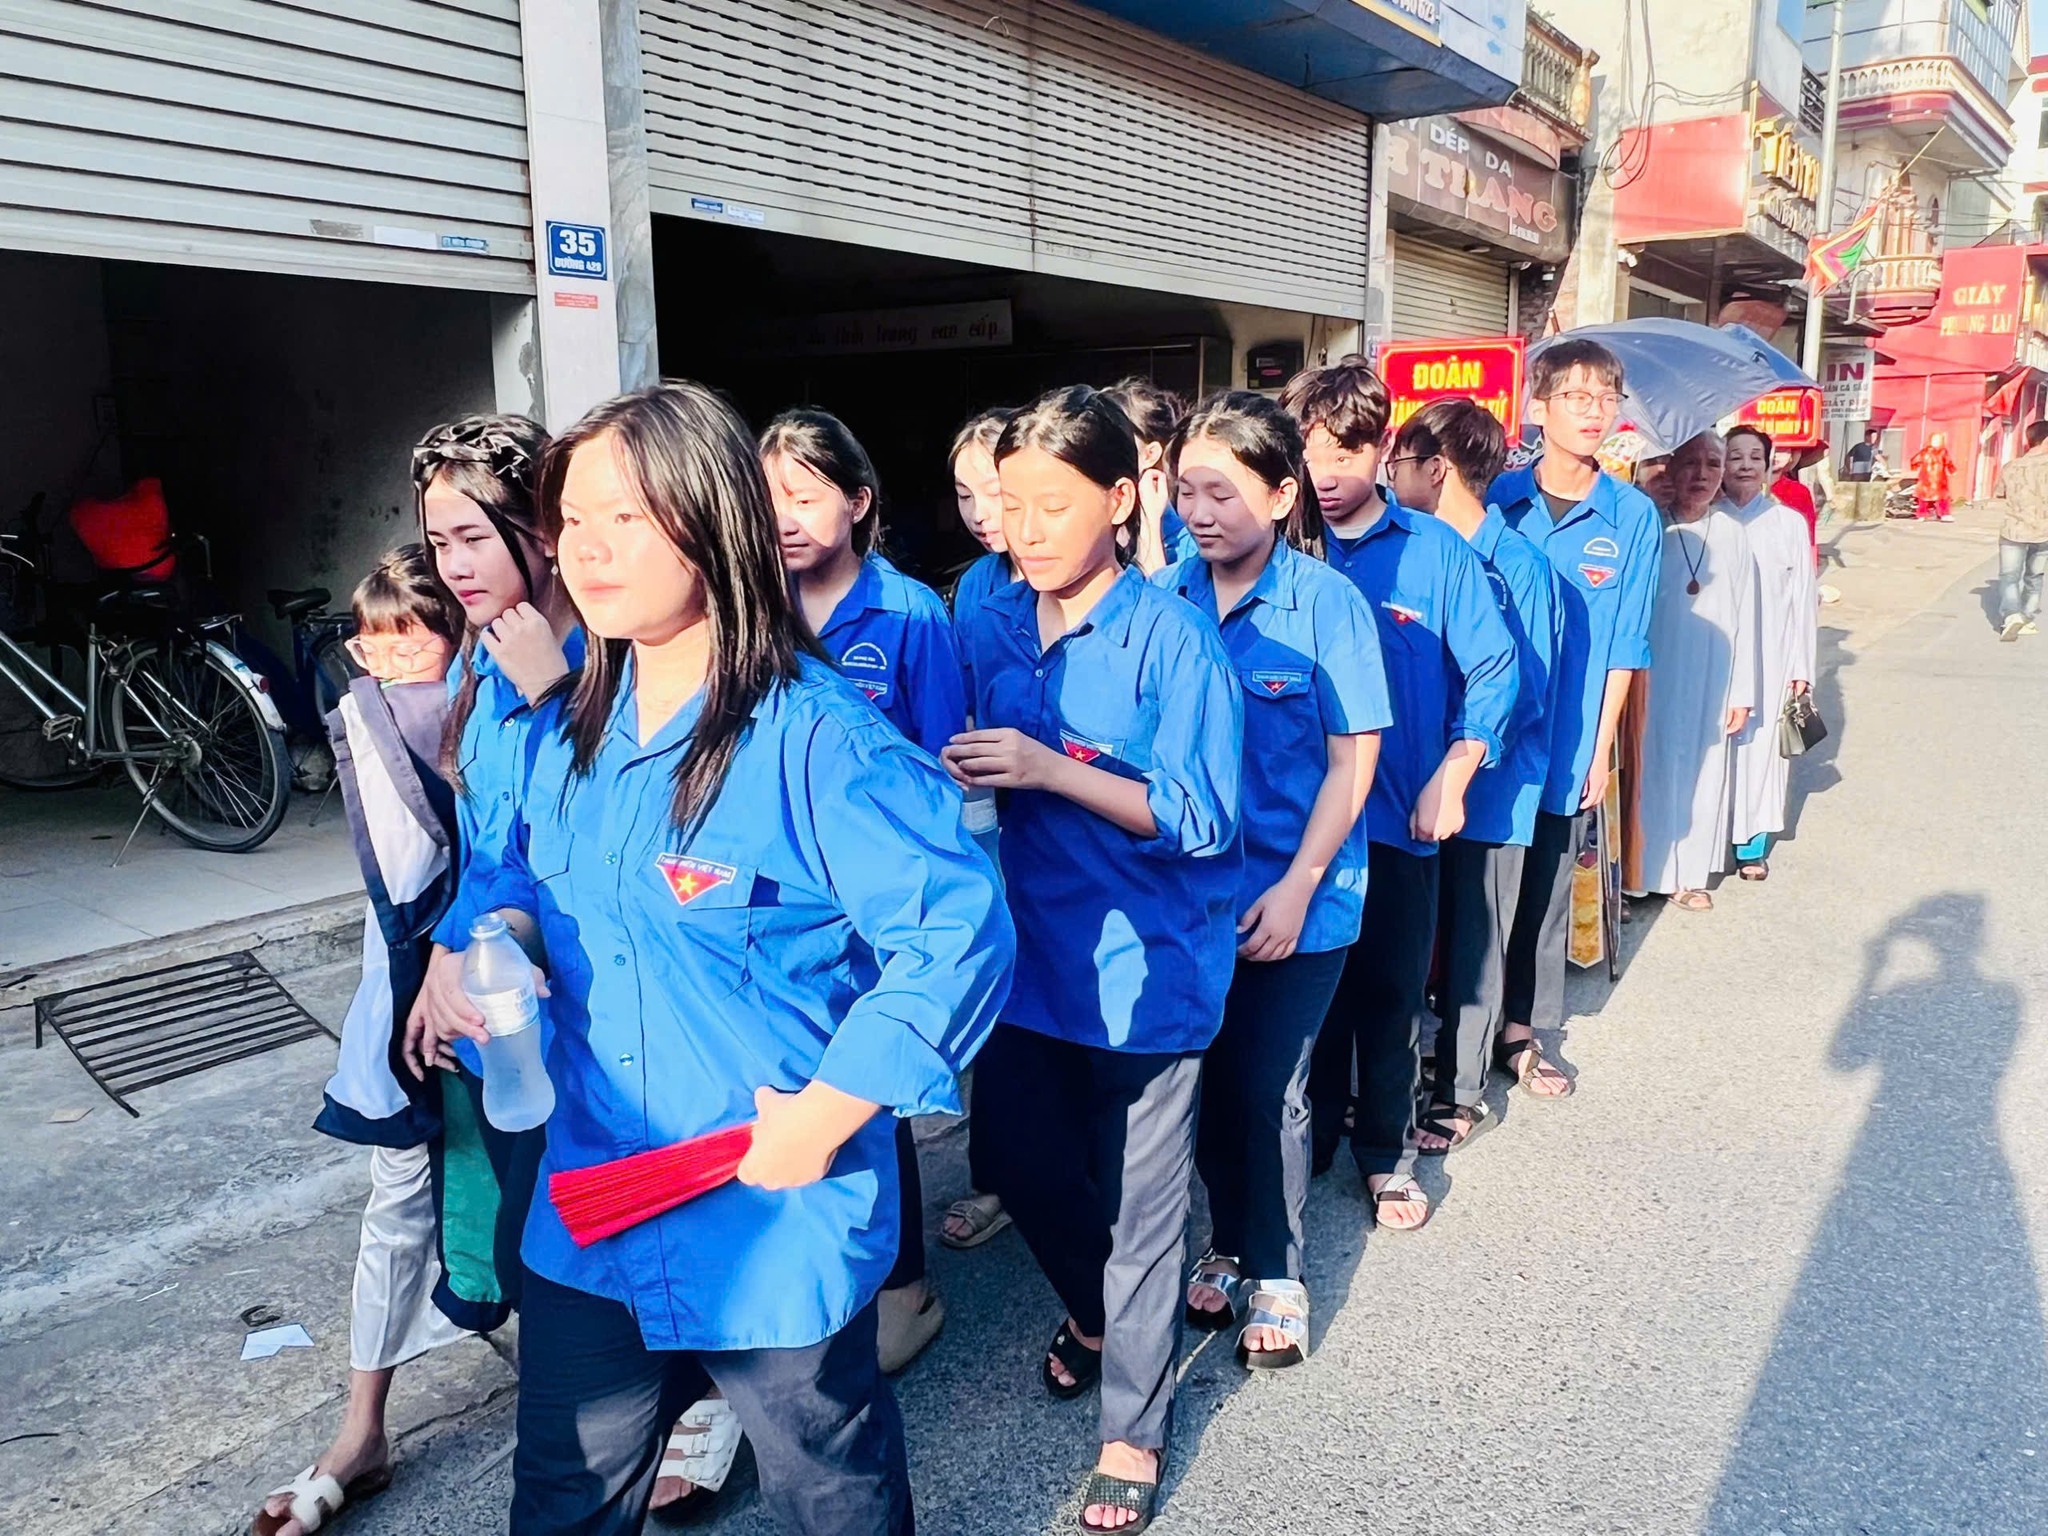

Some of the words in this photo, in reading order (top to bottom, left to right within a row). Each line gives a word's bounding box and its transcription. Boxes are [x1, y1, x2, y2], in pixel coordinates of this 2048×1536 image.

[1430, 123, 1470, 154] DÉP
[1485, 151, 1512, 178] DA
[560, 230, 596, 256] 35
[1413, 355, 1481, 390] ĐOÀN
[1827, 362, 1864, 381] IN
